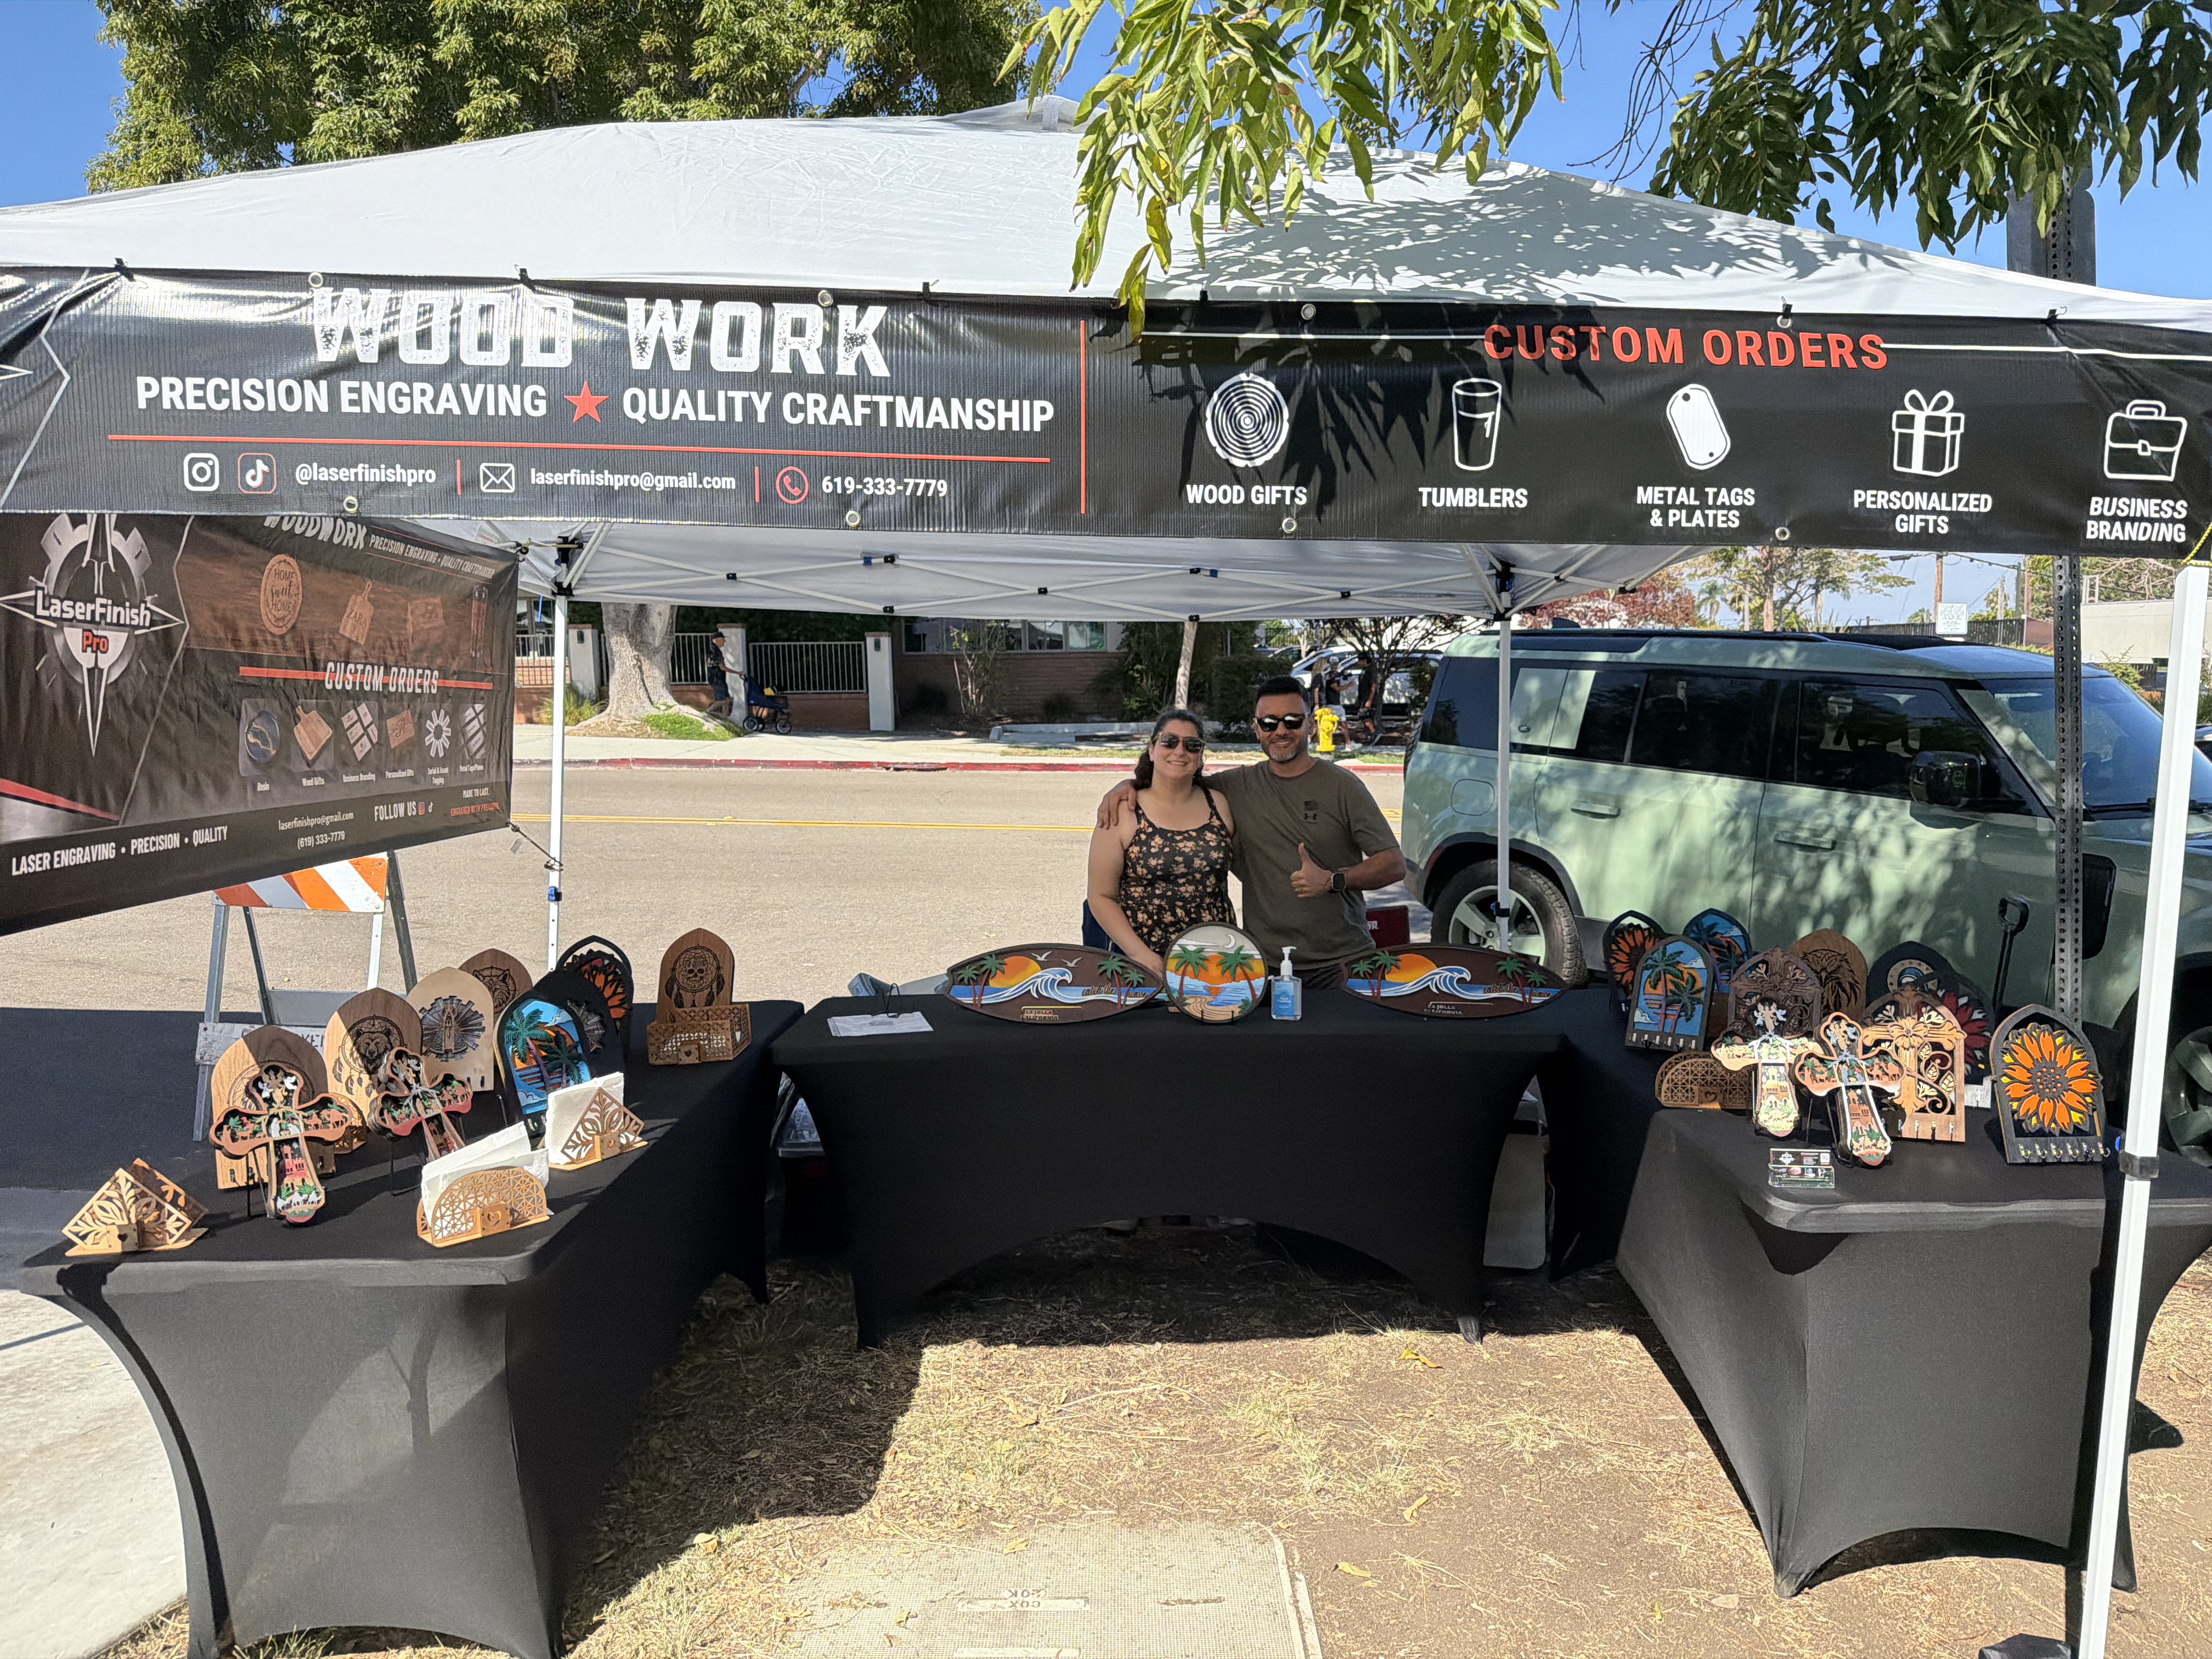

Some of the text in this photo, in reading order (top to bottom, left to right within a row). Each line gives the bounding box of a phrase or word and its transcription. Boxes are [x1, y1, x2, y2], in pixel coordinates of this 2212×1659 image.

[312, 286, 890, 377] WOOD WORK
[1484, 325, 1888, 370] CUSTOM ORDERS
[137, 376, 548, 418] PRECISION ENGRAVING
[623, 387, 1054, 432] QUALITY CRAFTMANSHIP
[296, 463, 436, 486] @laserfinishpro
[531, 468, 736, 492] laserfinishpro@gmail.com
[822, 476, 947, 498] 619-333-7779
[1186, 485, 1307, 505] WOOD GIFTS
[1419, 487, 1527, 508] TUMBLERS
[1636, 487, 1755, 506] METAL TAGS
[1854, 489, 1992, 512] PERSONALIZED
[2090, 497, 2188, 519] BUSINESS
[1650, 509, 1740, 528] & PLATES
[1895, 515, 1949, 534] GIFTS
[2087, 520, 2186, 542] BRANDING
[369, 534, 439, 564] PRECISION ENGRAVING
[440, 555, 464, 569] QUALITY
[274, 568, 295, 582] HOME
[36, 589, 151, 627] LaserFinish
[271, 600, 291, 612] HOME
[347, 608, 367, 627] ZARA
[82, 631, 109, 652] Pro
[325, 662, 439, 695] CUSTOM ORDERS
[257, 781, 270, 792] Resin
[302, 777, 325, 787] Wood Gifts
[343, 774, 359, 783] Business
[462, 789, 473, 798] MADE
[474, 789, 479, 797] TO
[278, 811, 354, 831] laserfinishpro@gmail.com
[374, 800, 417, 822] FOLLOW US
[297, 830, 345, 850] (619) 333-7779
[12, 826, 228, 876] LASER ENGRAVING PRECISION QUALITY
[1008, 1600, 1041, 1609] COX
